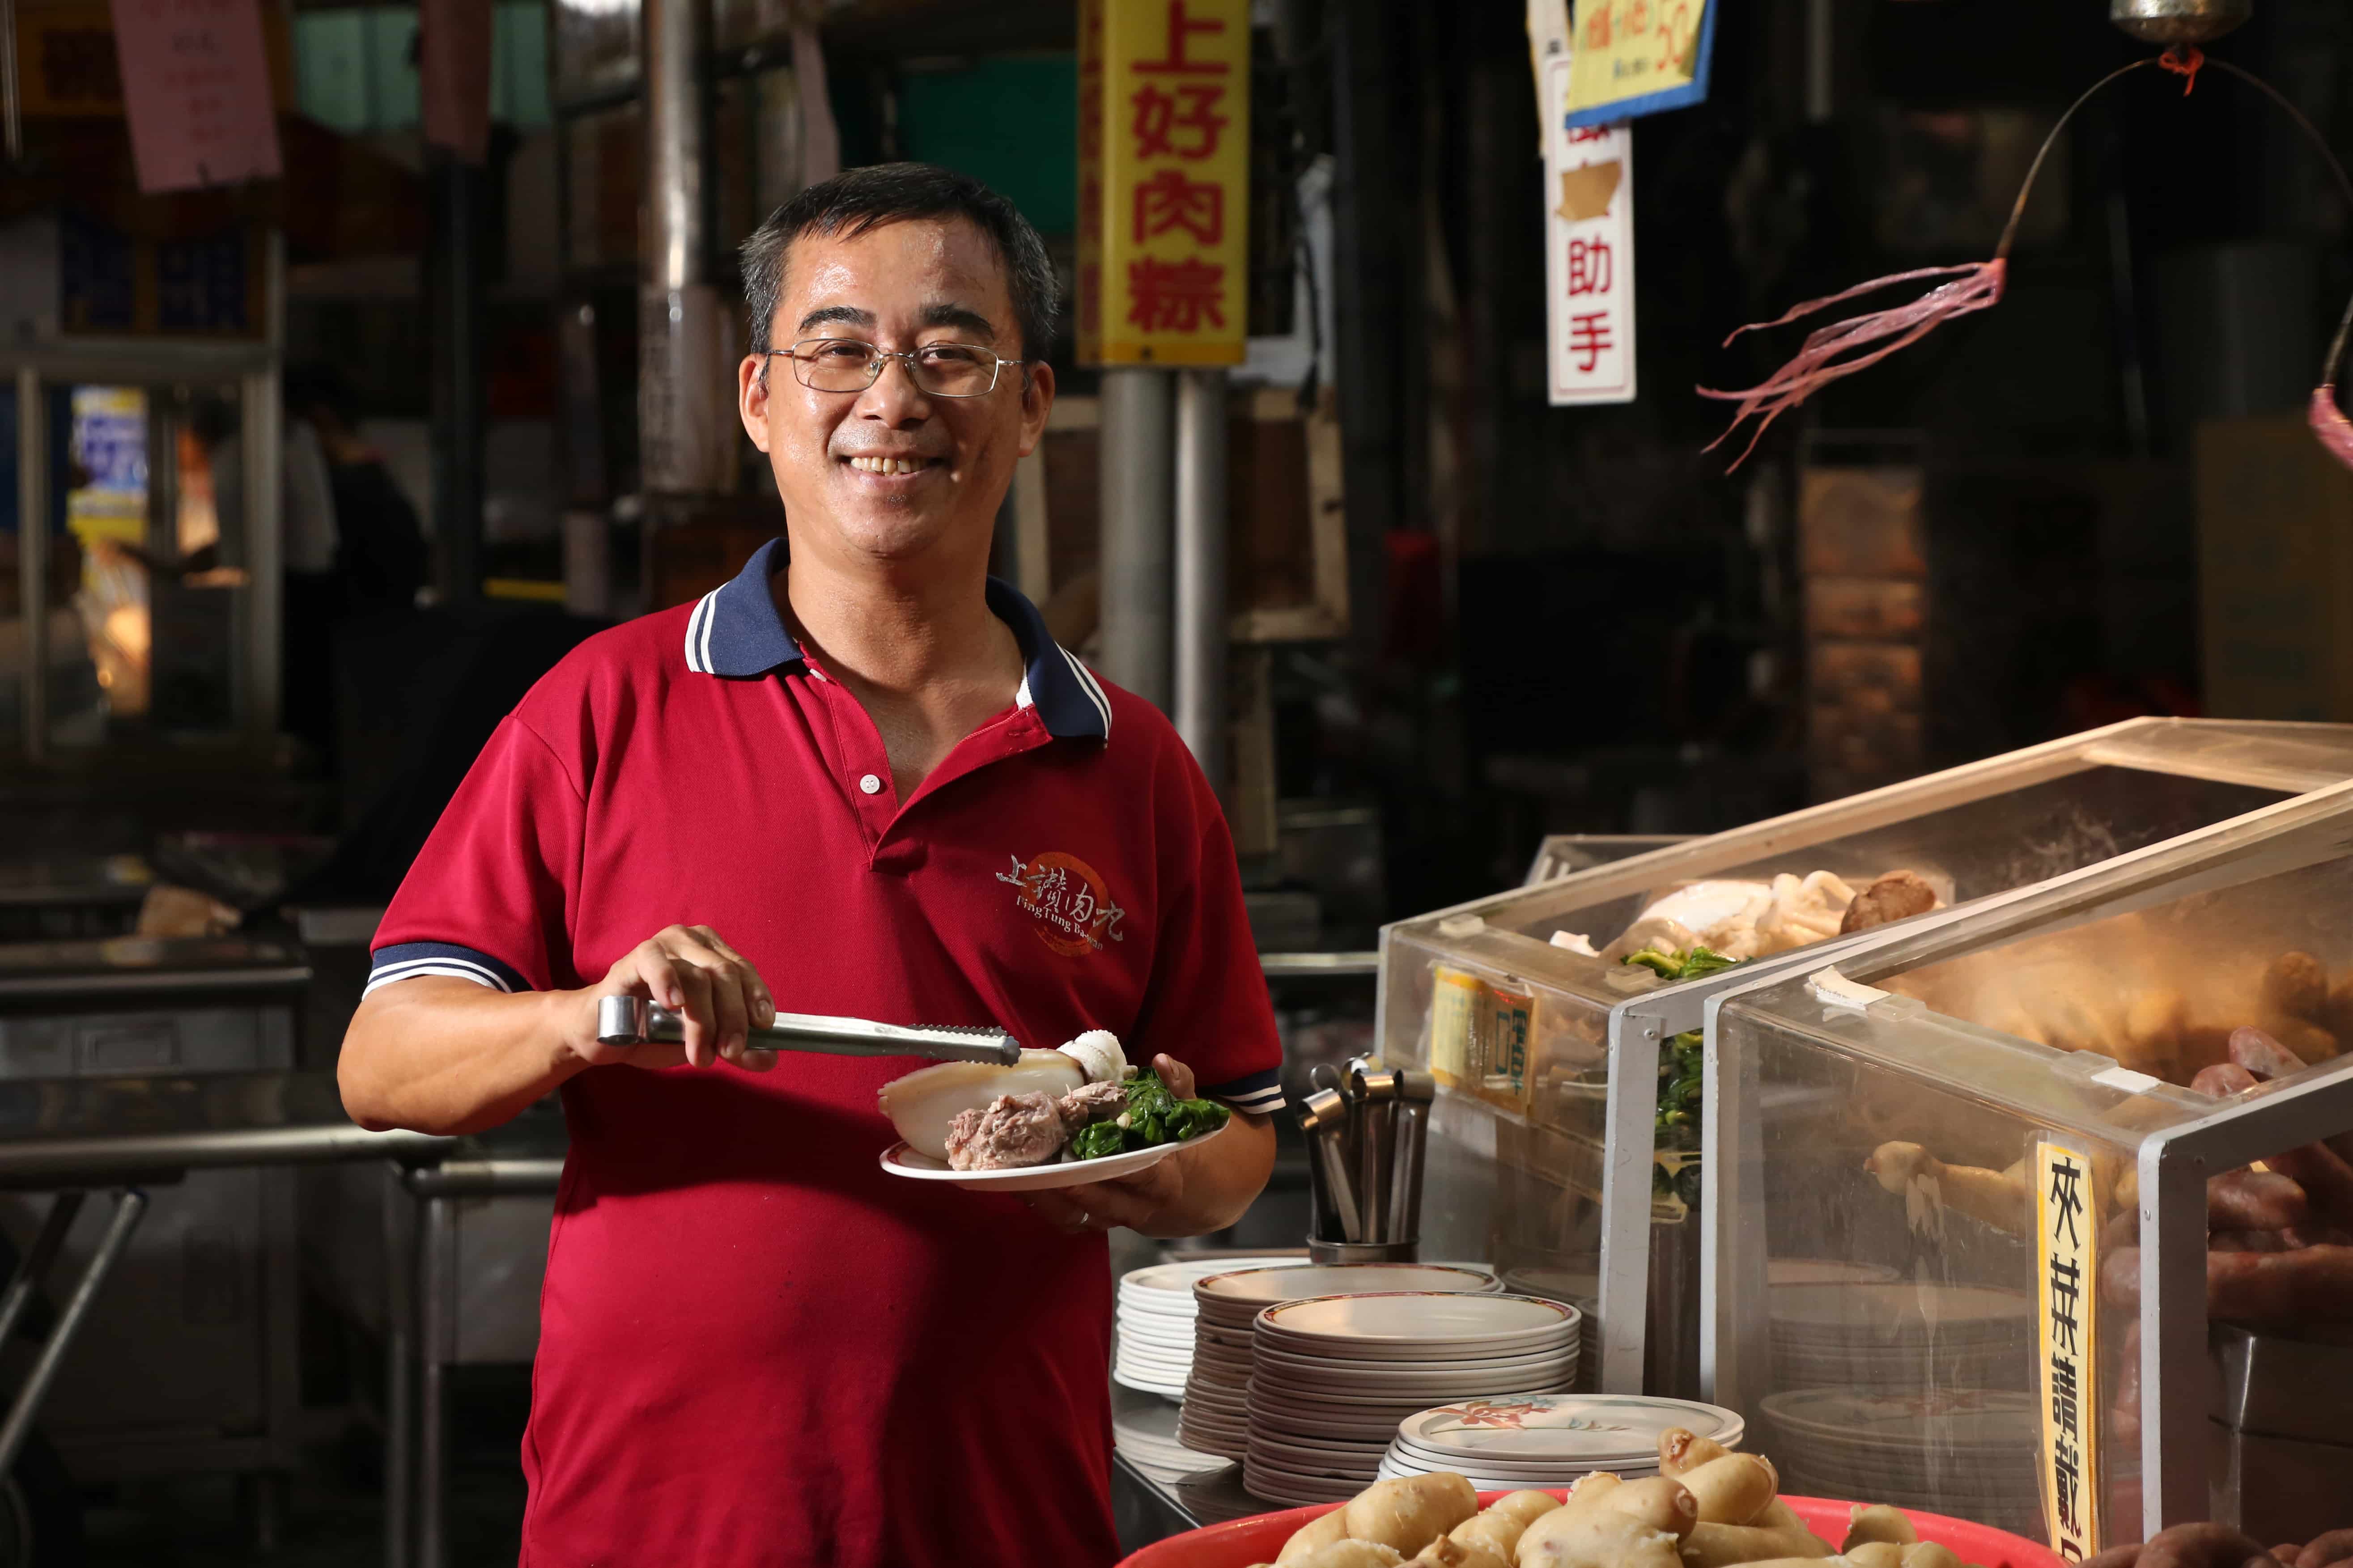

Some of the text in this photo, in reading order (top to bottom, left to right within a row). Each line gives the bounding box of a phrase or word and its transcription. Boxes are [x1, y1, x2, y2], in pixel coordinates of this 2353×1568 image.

[1126, 0, 1230, 334] 上好肉粽
[1016, 895, 1071, 933] PingTung
